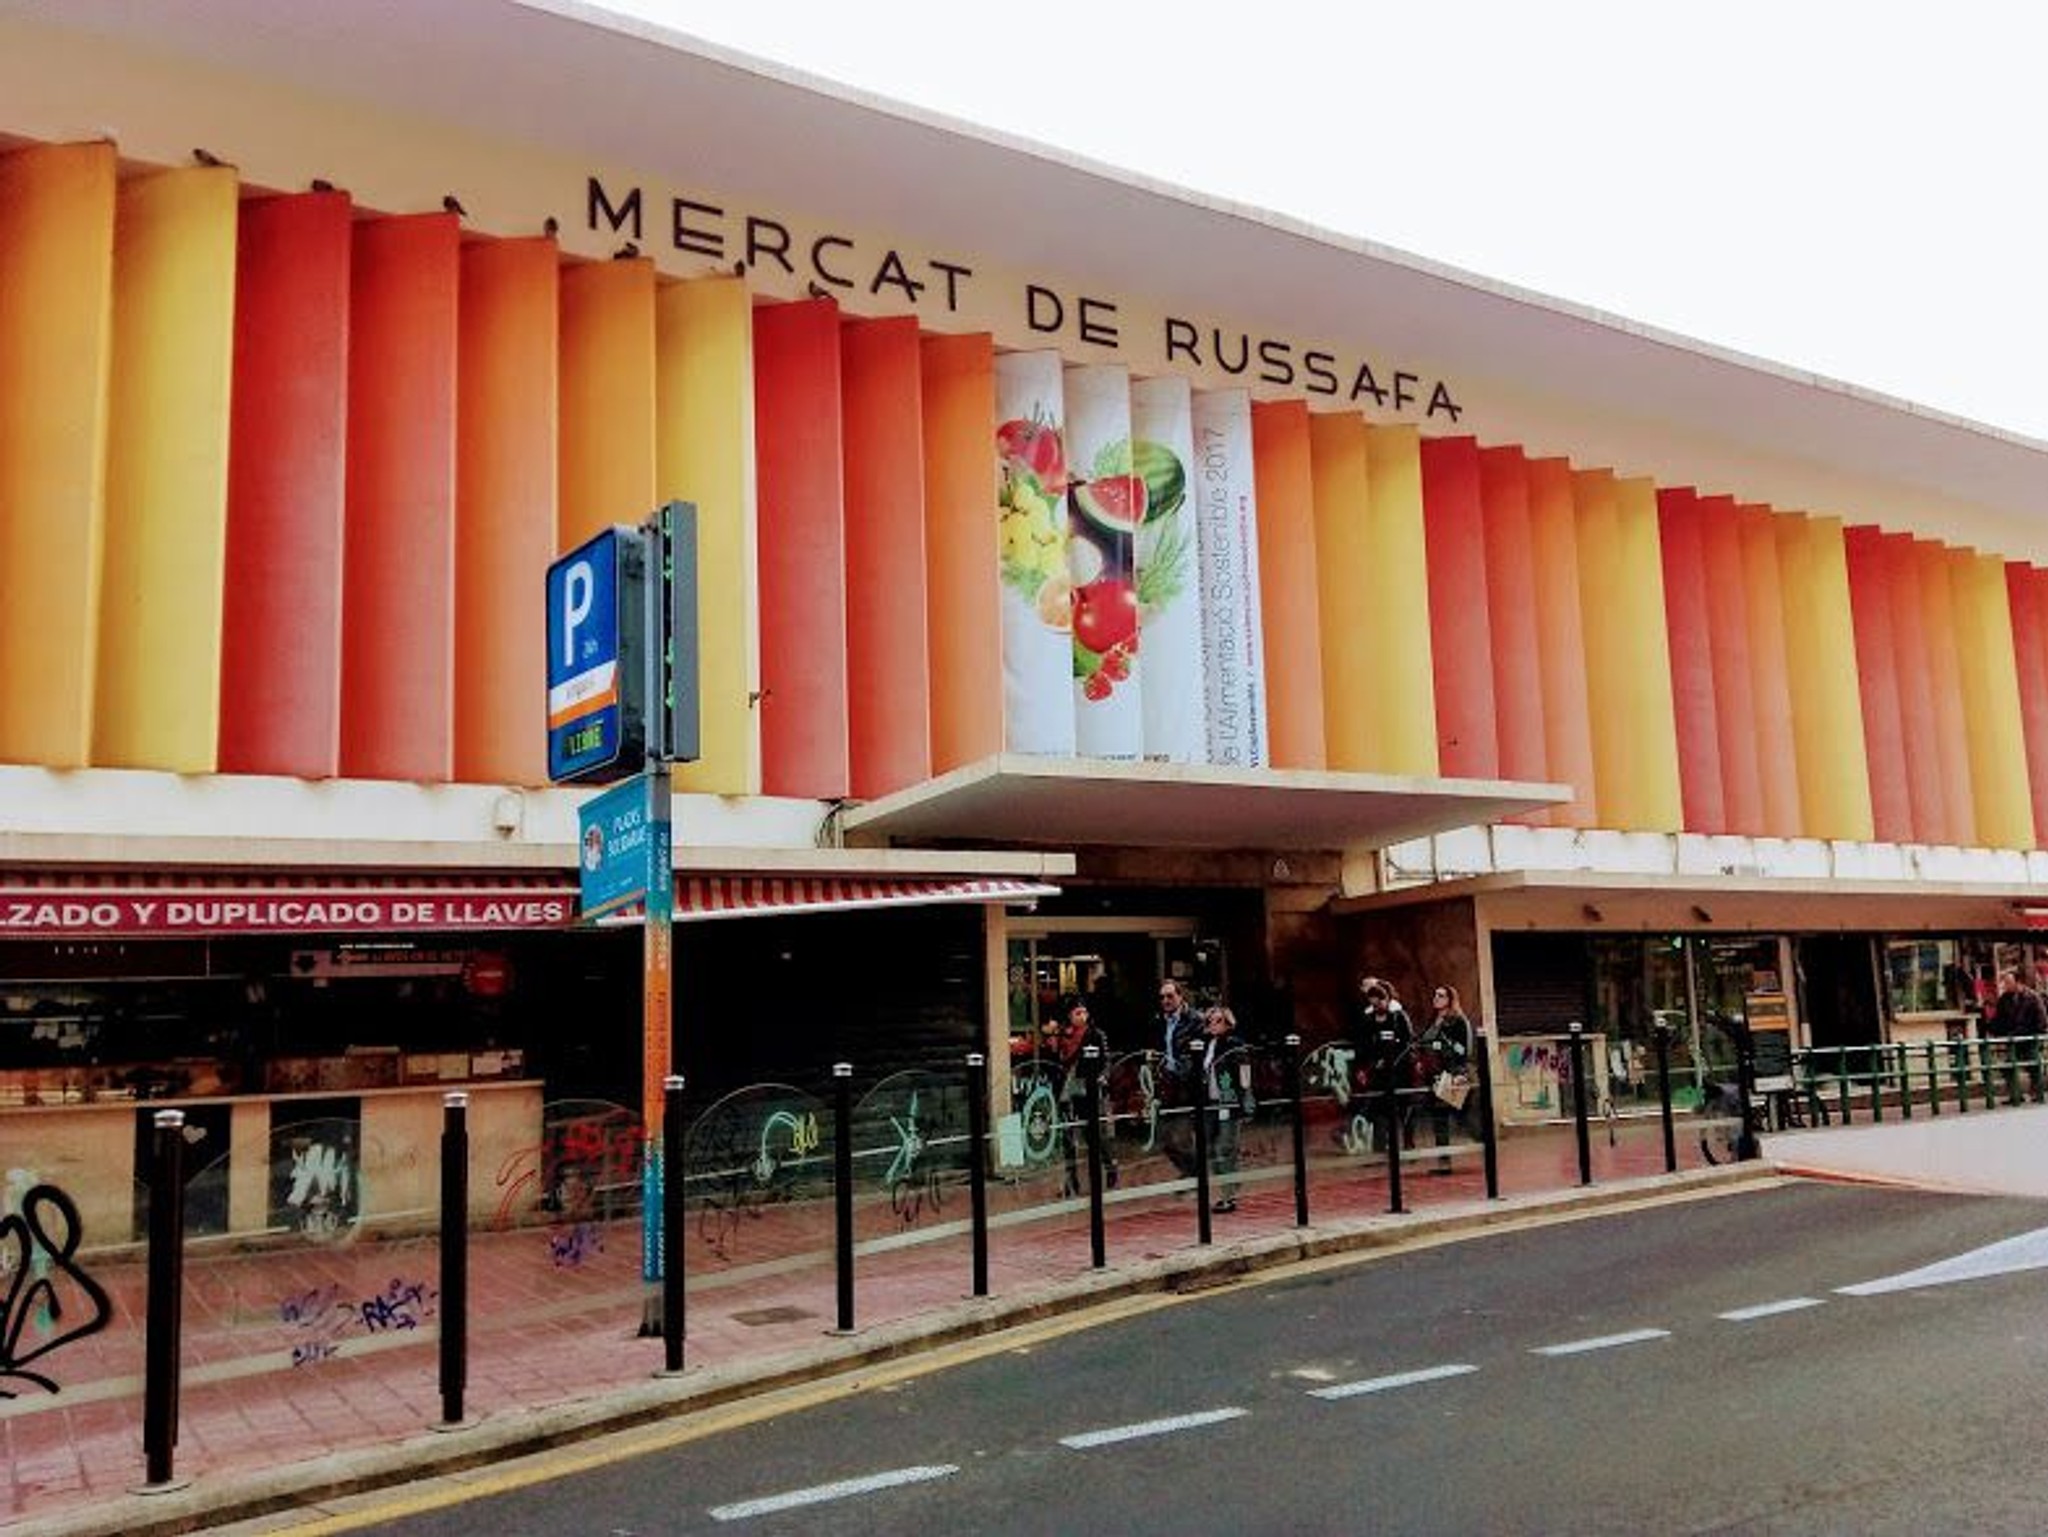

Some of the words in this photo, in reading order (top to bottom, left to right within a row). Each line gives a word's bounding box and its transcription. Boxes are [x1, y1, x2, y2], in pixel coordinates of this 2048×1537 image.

[587, 176, 972, 312] MERCAT
[1026, 283, 1119, 349] DE
[1166, 318, 1463, 423] RUSSAFA
[1203, 427, 1228, 483] 2017
[1203, 486, 1234, 601] Sostenible
[564, 560, 593, 667] P
[0, 904, 120, 926] ZADO
[130, 902, 157, 926] Y
[166, 902, 380, 925] DUPLICADO
[391, 902, 435, 923] DE
[445, 901, 563, 923] LLAVES
